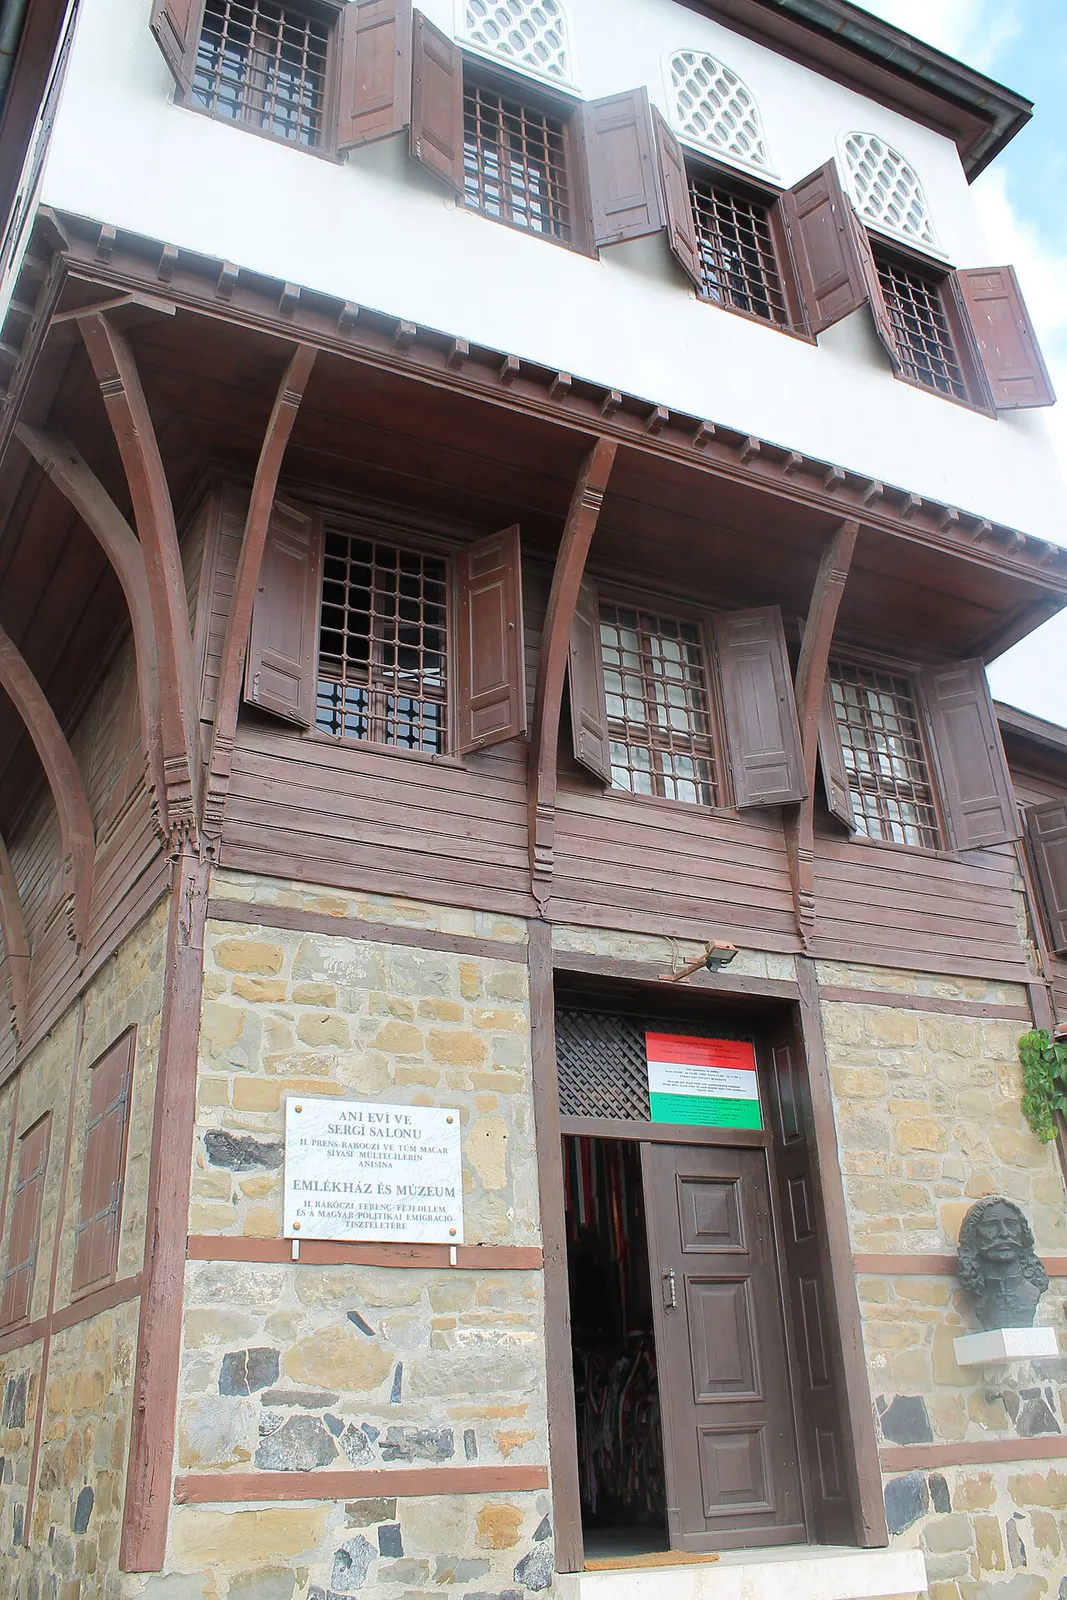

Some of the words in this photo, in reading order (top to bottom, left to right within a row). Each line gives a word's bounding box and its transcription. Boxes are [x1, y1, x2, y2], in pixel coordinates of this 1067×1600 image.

[339, 1112, 362, 1122] ANI
[368, 1111, 389, 1124] EVİ
[394, 1114, 412, 1125] VE
[327, 1123, 365, 1135] SERGİ
[370, 1127, 422, 1140] SALONU
[311, 1139, 338, 1148] PRENS
[399, 1144, 418, 1152] TÜM
[420, 1146, 448, 1154] MACAR
[293, 1179, 372, 1194] EMLÉKHÁZ
[377, 1182, 391, 1195] ÉS
[396, 1184, 456, 1197] MÚZEUM
[315, 1200, 354, 1210] RÁKÓCZI
[359, 1202, 392, 1211] FERENC
[397, 1204, 446, 1213] FEJEDELEM
[318, 1211, 354, 1219] MAGYAR
[358, 1212, 402, 1221] POLITIKAI
